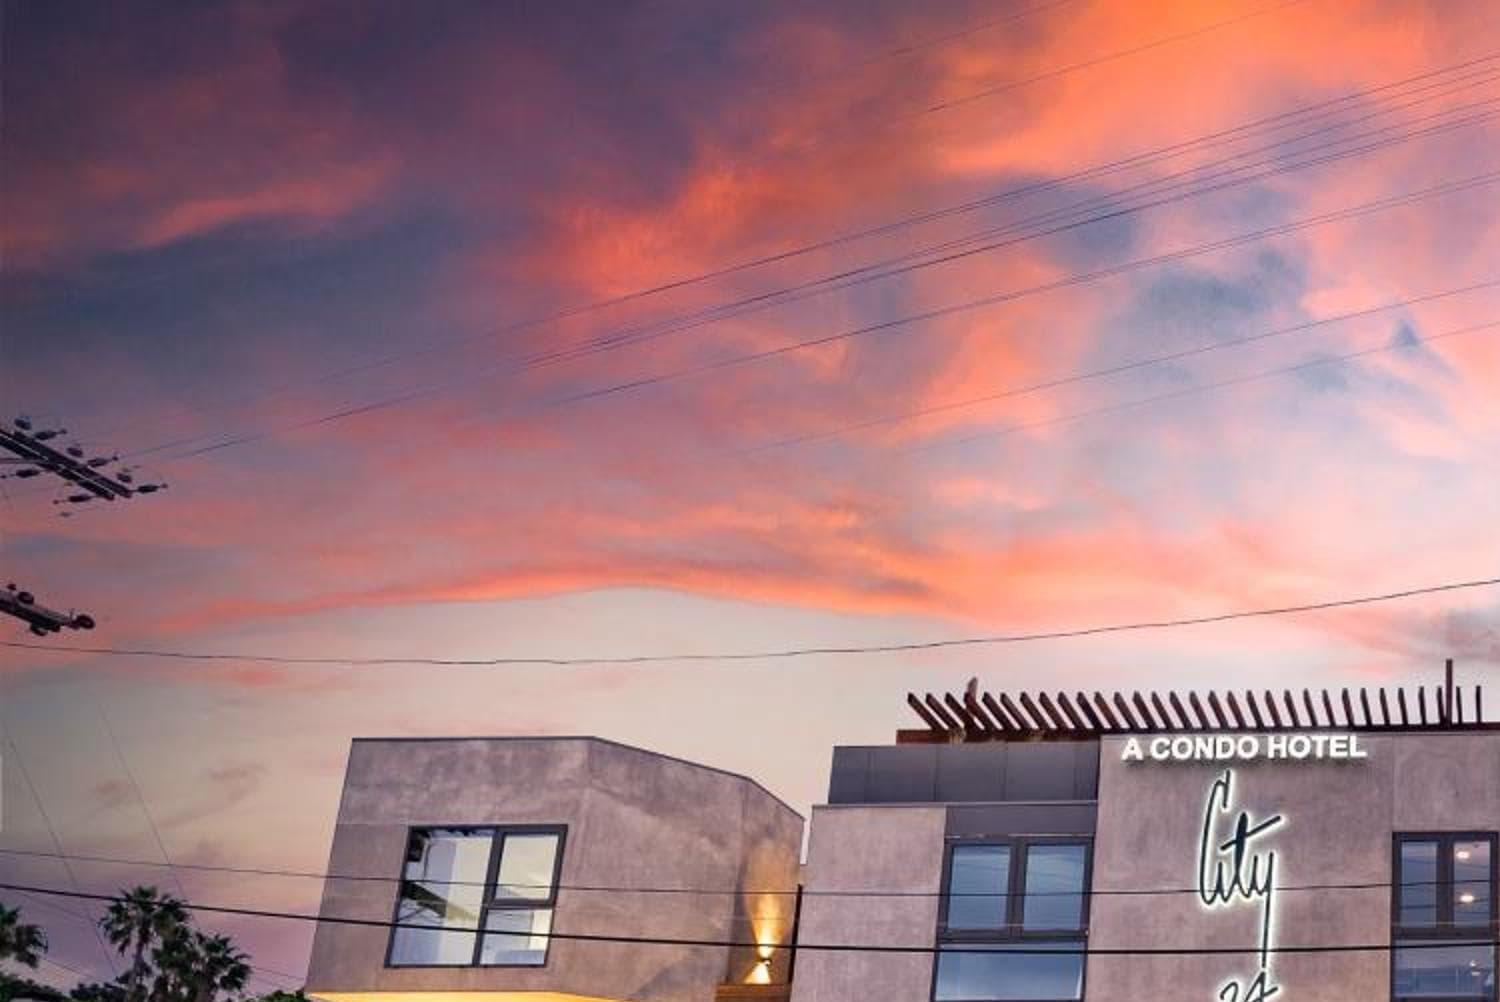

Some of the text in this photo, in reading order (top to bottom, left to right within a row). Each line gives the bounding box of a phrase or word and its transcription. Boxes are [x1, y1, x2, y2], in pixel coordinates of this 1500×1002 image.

[1121, 734, 1368, 761] A CONDO HOTEL
[1199, 769, 1283, 970] City
